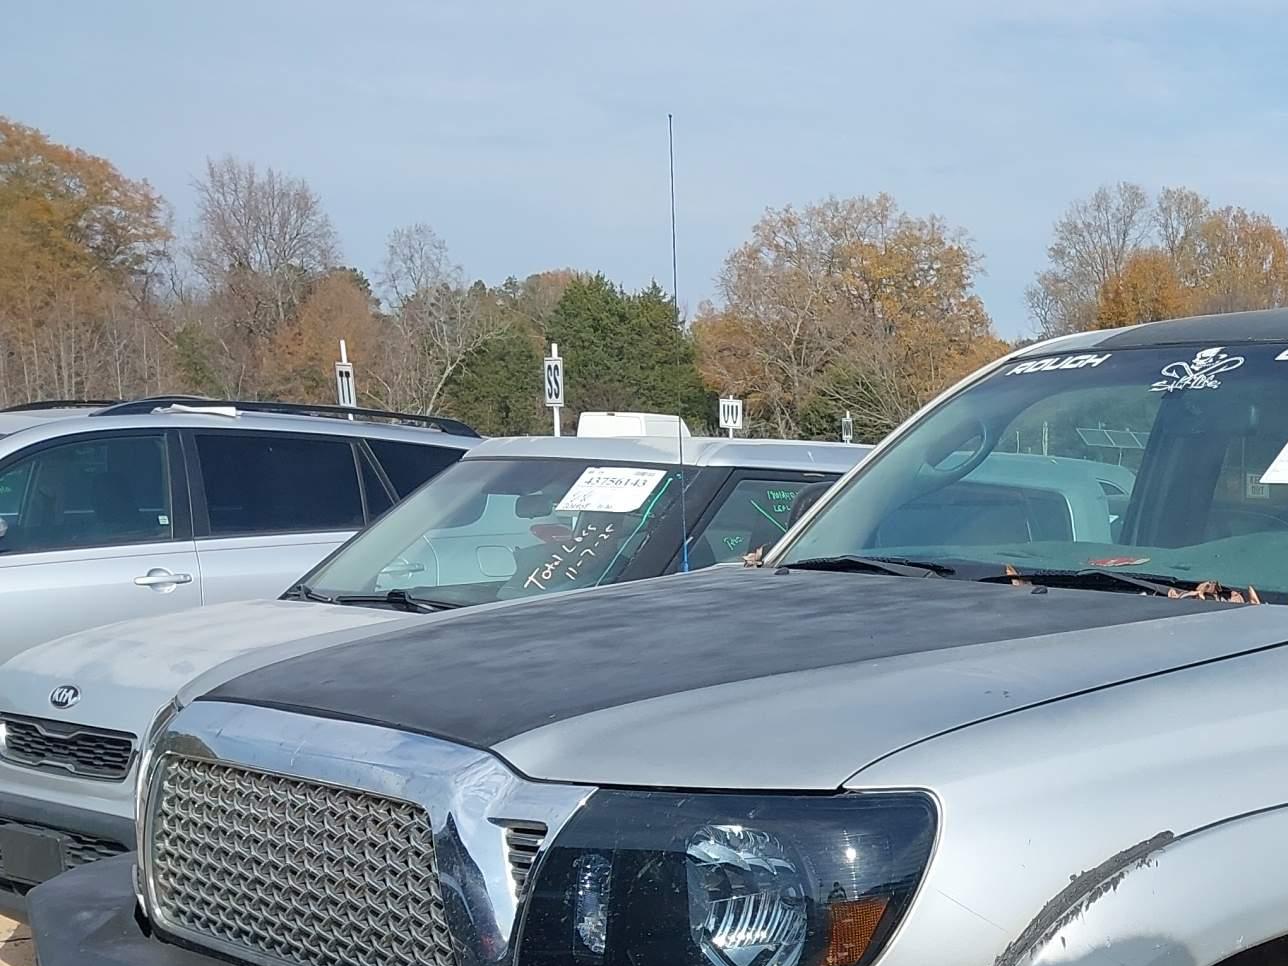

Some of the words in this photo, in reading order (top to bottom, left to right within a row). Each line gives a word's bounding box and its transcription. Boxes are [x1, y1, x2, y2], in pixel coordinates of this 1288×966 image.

[1004, 353, 1112, 376] ROUGH
[338, 370, 353, 405] TT
[546, 364, 561, 400] SS
[583, 476, 650, 488] 43756143
[51, 686, 80, 706] KIA
